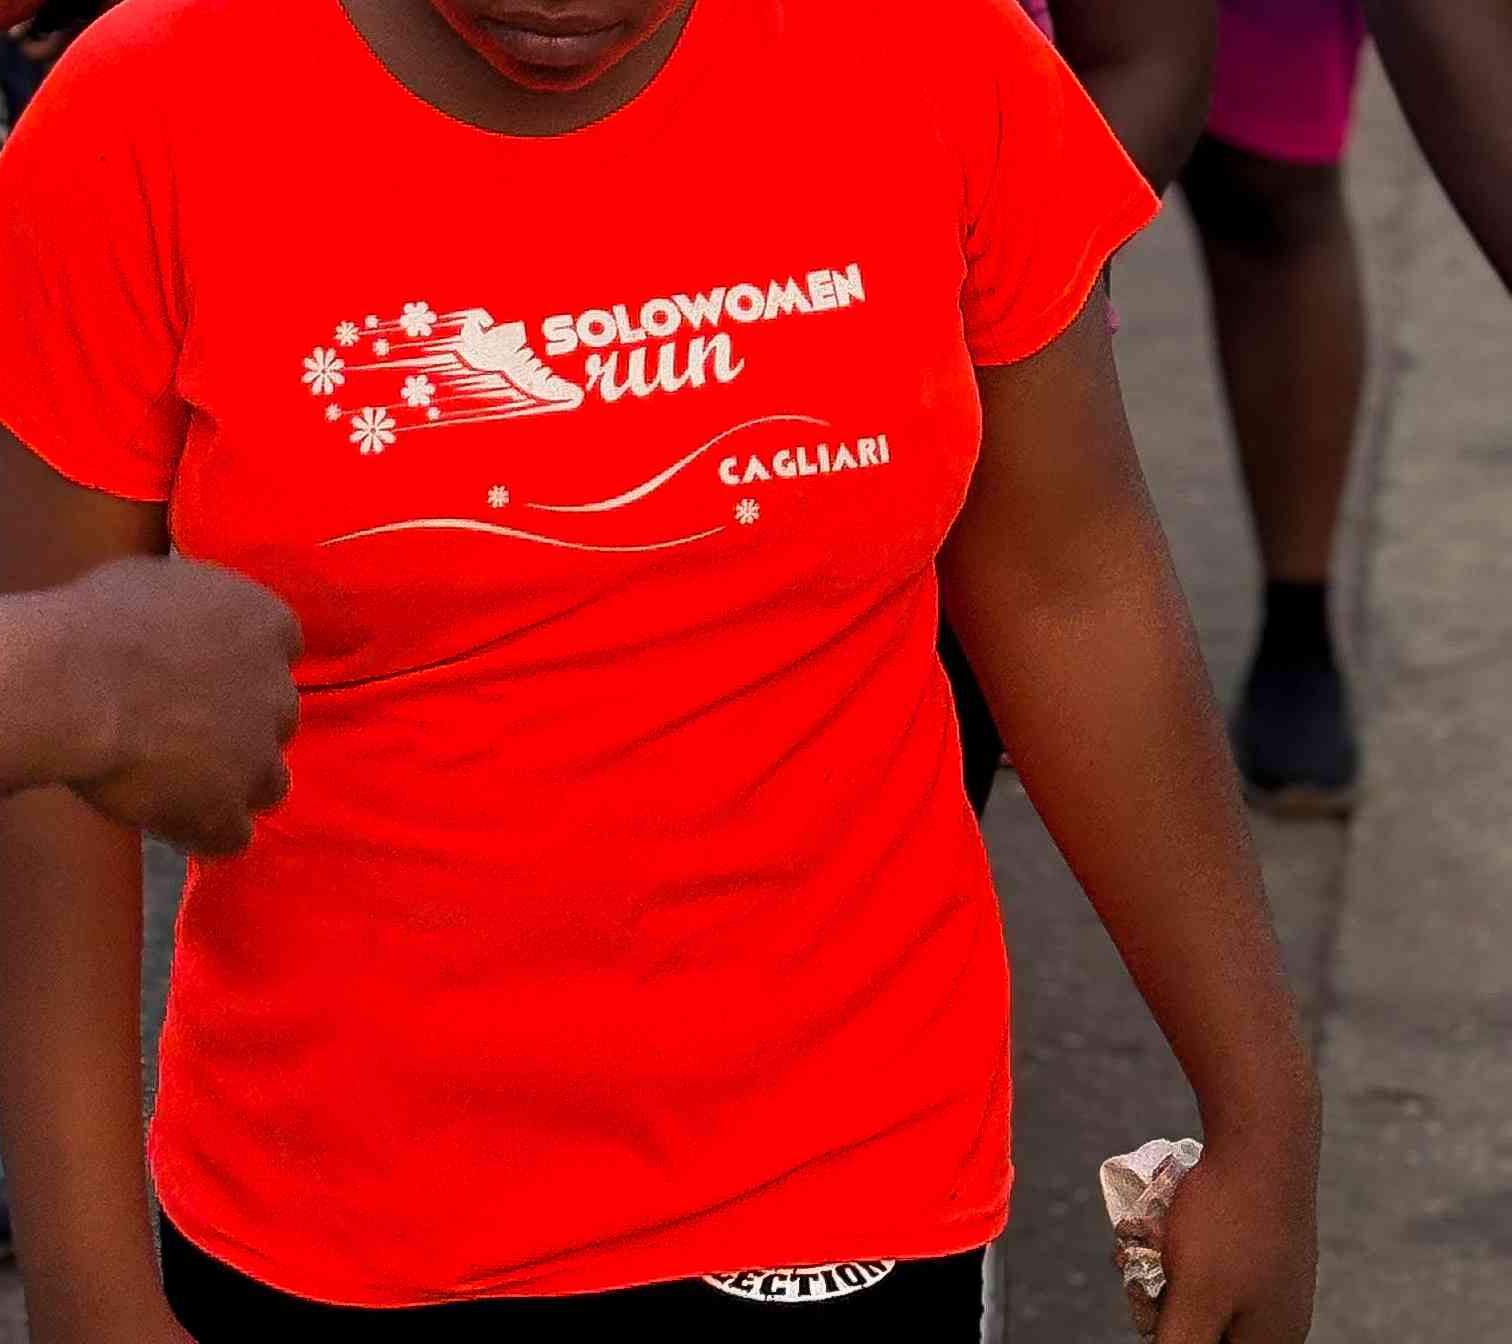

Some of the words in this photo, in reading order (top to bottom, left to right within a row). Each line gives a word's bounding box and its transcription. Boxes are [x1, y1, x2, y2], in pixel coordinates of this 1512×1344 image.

[542, 262, 865, 356] SOLOWOMEN
[585, 332, 745, 402] run
[718, 434, 891, 485] CAGLIARI
